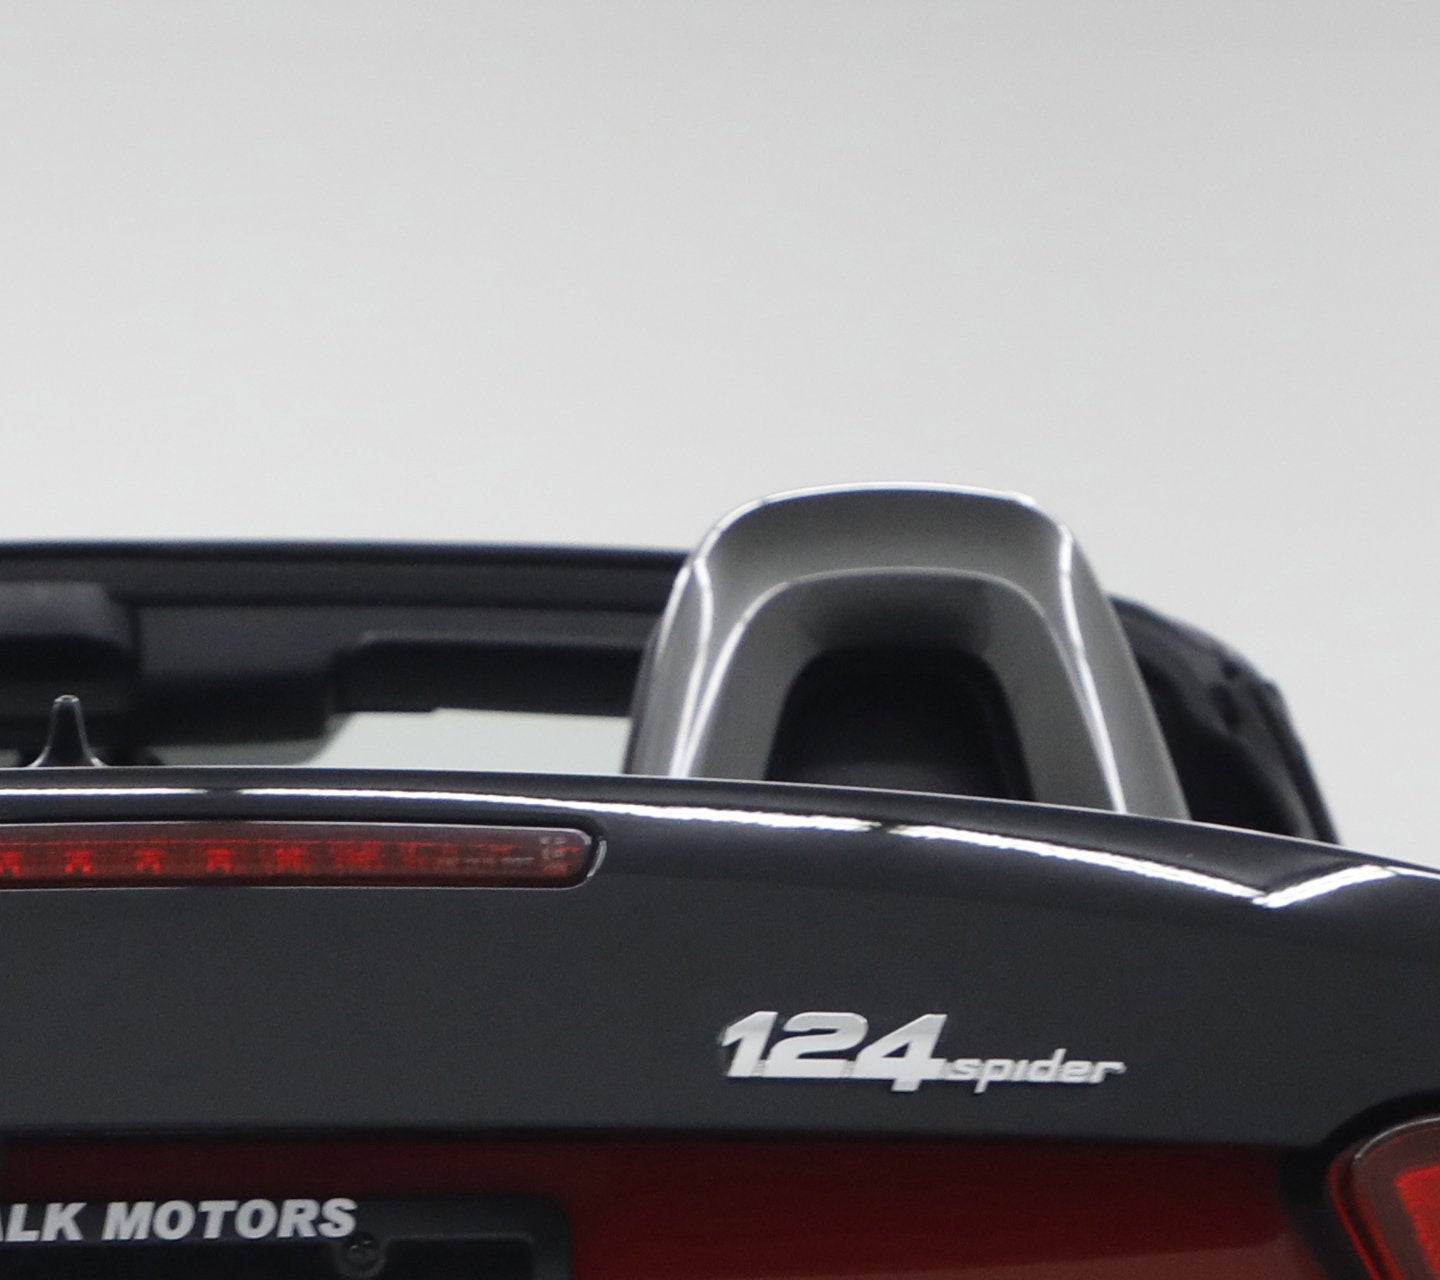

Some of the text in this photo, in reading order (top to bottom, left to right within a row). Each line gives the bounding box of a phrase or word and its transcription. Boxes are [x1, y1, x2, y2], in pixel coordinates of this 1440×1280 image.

[720, 1010, 1126, 1094] 124 spider
[101, 1198, 357, 1240] MOTORS
